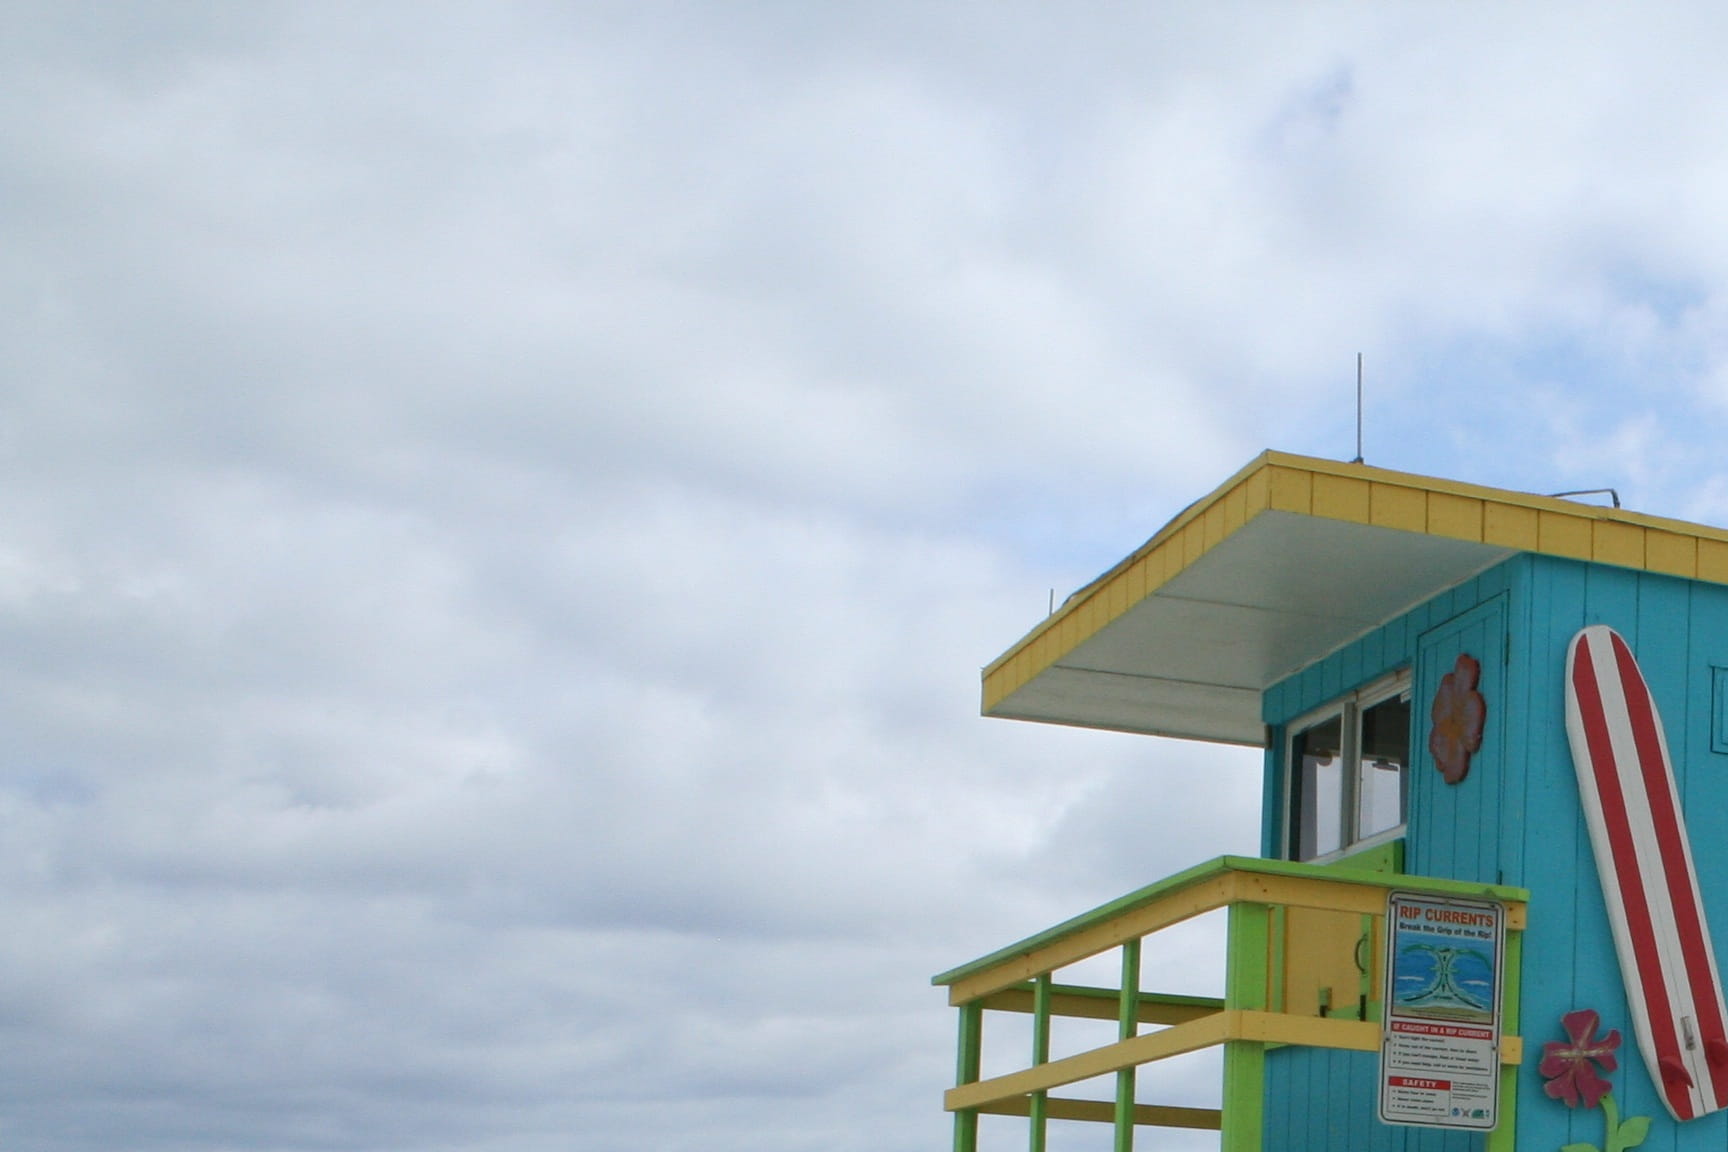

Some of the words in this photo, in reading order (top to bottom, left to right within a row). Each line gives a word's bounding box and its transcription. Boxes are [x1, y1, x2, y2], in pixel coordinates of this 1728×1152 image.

[1400, 905, 1421, 919] RIP
[1425, 908, 1494, 927] CURRENTS
[1400, 921, 1421, 930] Break
[1423, 924, 1435, 932] the
[1437, 925, 1453, 936] Grip
[1454, 927, 1462, 935] of
[1464, 929, 1476, 937] the
[1401, 1023, 1429, 1034] CAUGHT
[1402, 1078, 1438, 1089] SAFETY
